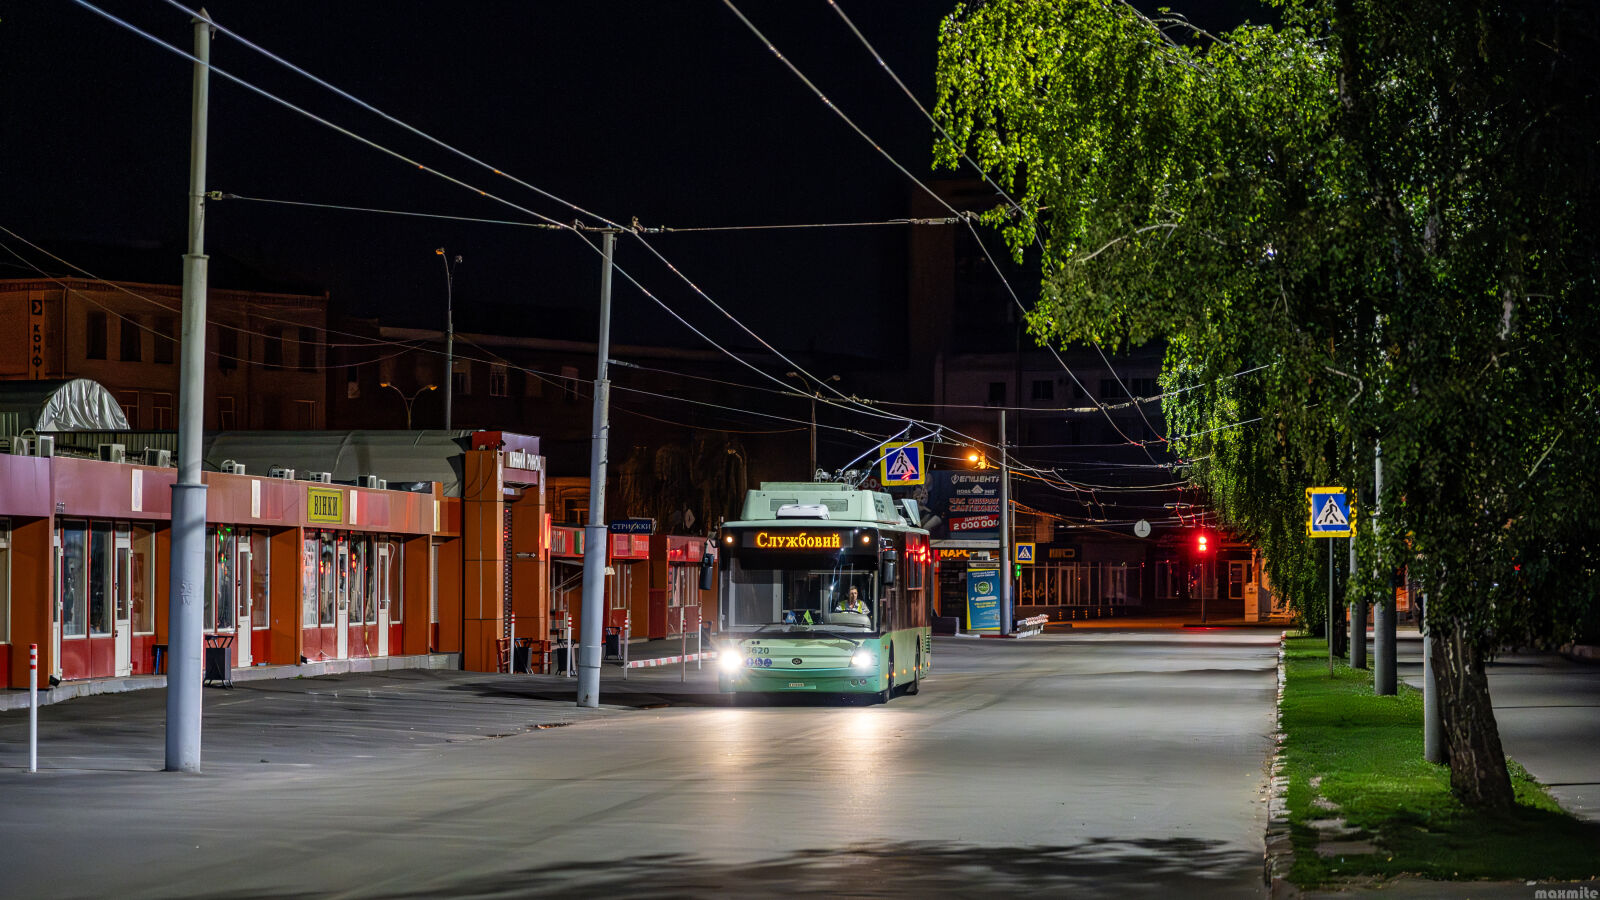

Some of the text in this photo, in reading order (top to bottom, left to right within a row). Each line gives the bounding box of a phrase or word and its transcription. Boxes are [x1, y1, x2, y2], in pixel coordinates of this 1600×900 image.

[314, 495, 338, 516] ВІНКИ
[961, 521, 980, 529] 000
[757, 532, 841, 548] Службовий
